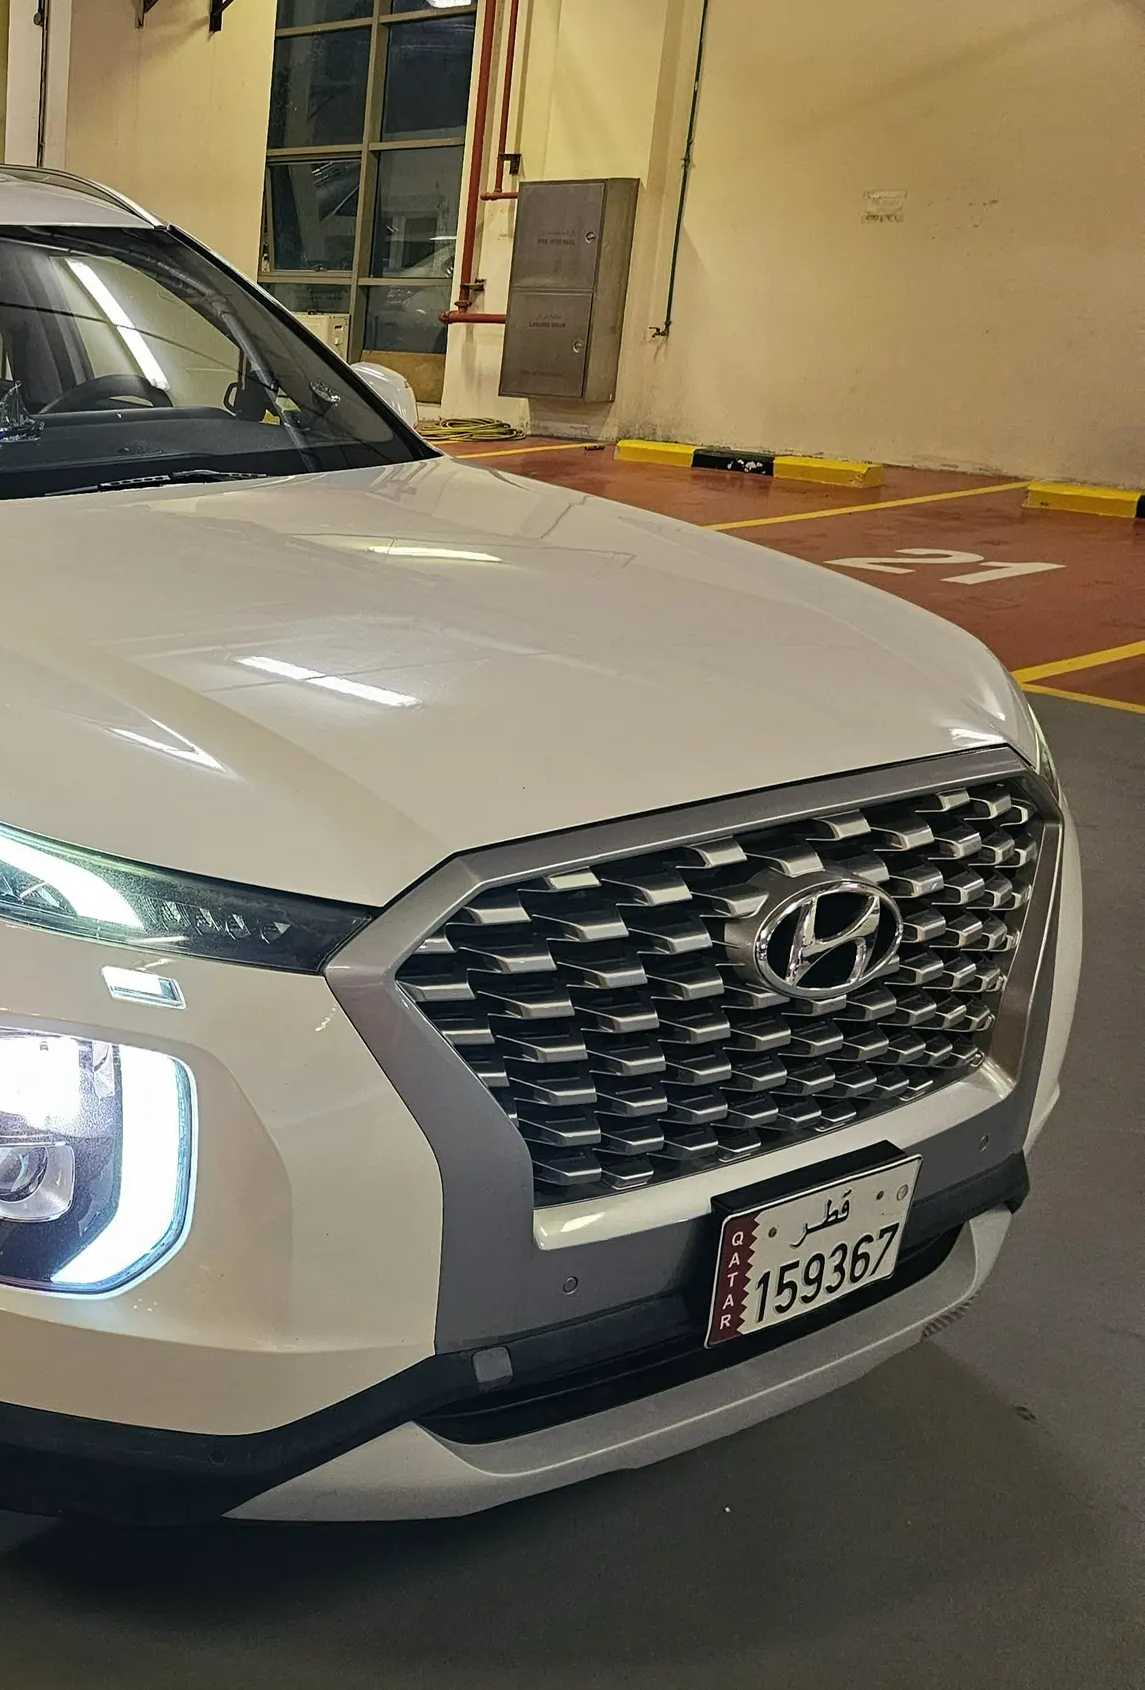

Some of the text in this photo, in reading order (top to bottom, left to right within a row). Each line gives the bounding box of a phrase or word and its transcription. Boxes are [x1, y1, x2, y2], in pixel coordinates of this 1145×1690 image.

[823, 547, 1067, 585] 21
[789, 1189, 852, 1249] قطر
[719, 1230, 745, 1331] QATAR
[755, 1221, 900, 1324] 159367
